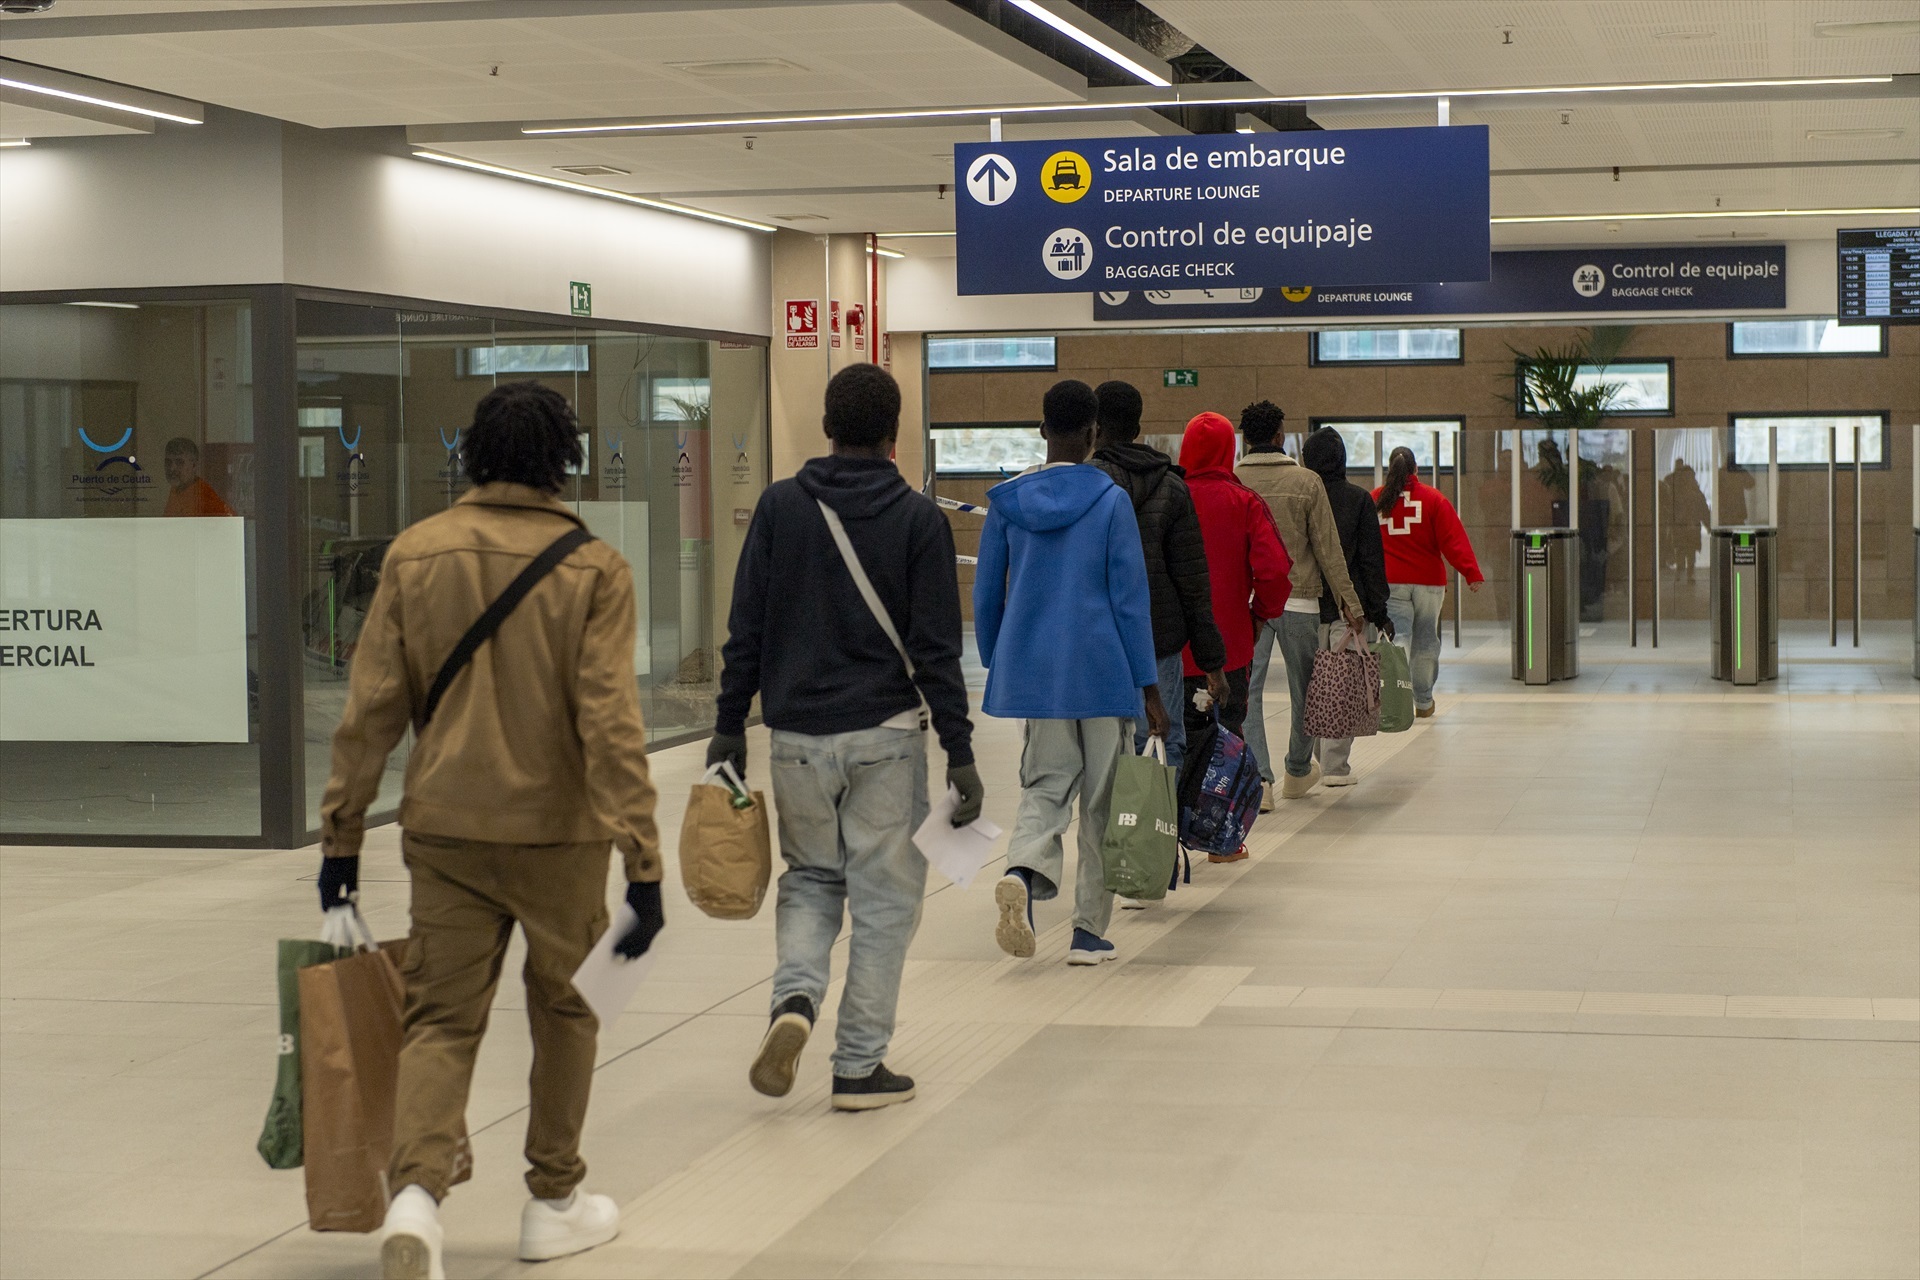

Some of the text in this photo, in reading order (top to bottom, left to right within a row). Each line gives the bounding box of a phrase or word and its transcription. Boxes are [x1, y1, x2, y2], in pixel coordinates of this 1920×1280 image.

[1103, 143, 1346, 172] Sala de embarque
[1104, 185, 1260, 203] DEPARTURE LOUNGE
[1105, 218, 1373, 249] Control de equipaje
[1105, 262, 1235, 279] BAGGAGE CHECK
[1612, 260, 1779, 280] Control de equipaje
[1318, 292, 1413, 303] DEPARTURE LOUNGE
[1612, 287, 1693, 297] BAGGAGE CHECK
[72, 474, 151, 484] Puerto de Ceuta
[0, 609, 103, 631] ERTURA
[0, 645, 95, 667] ERCIAL
